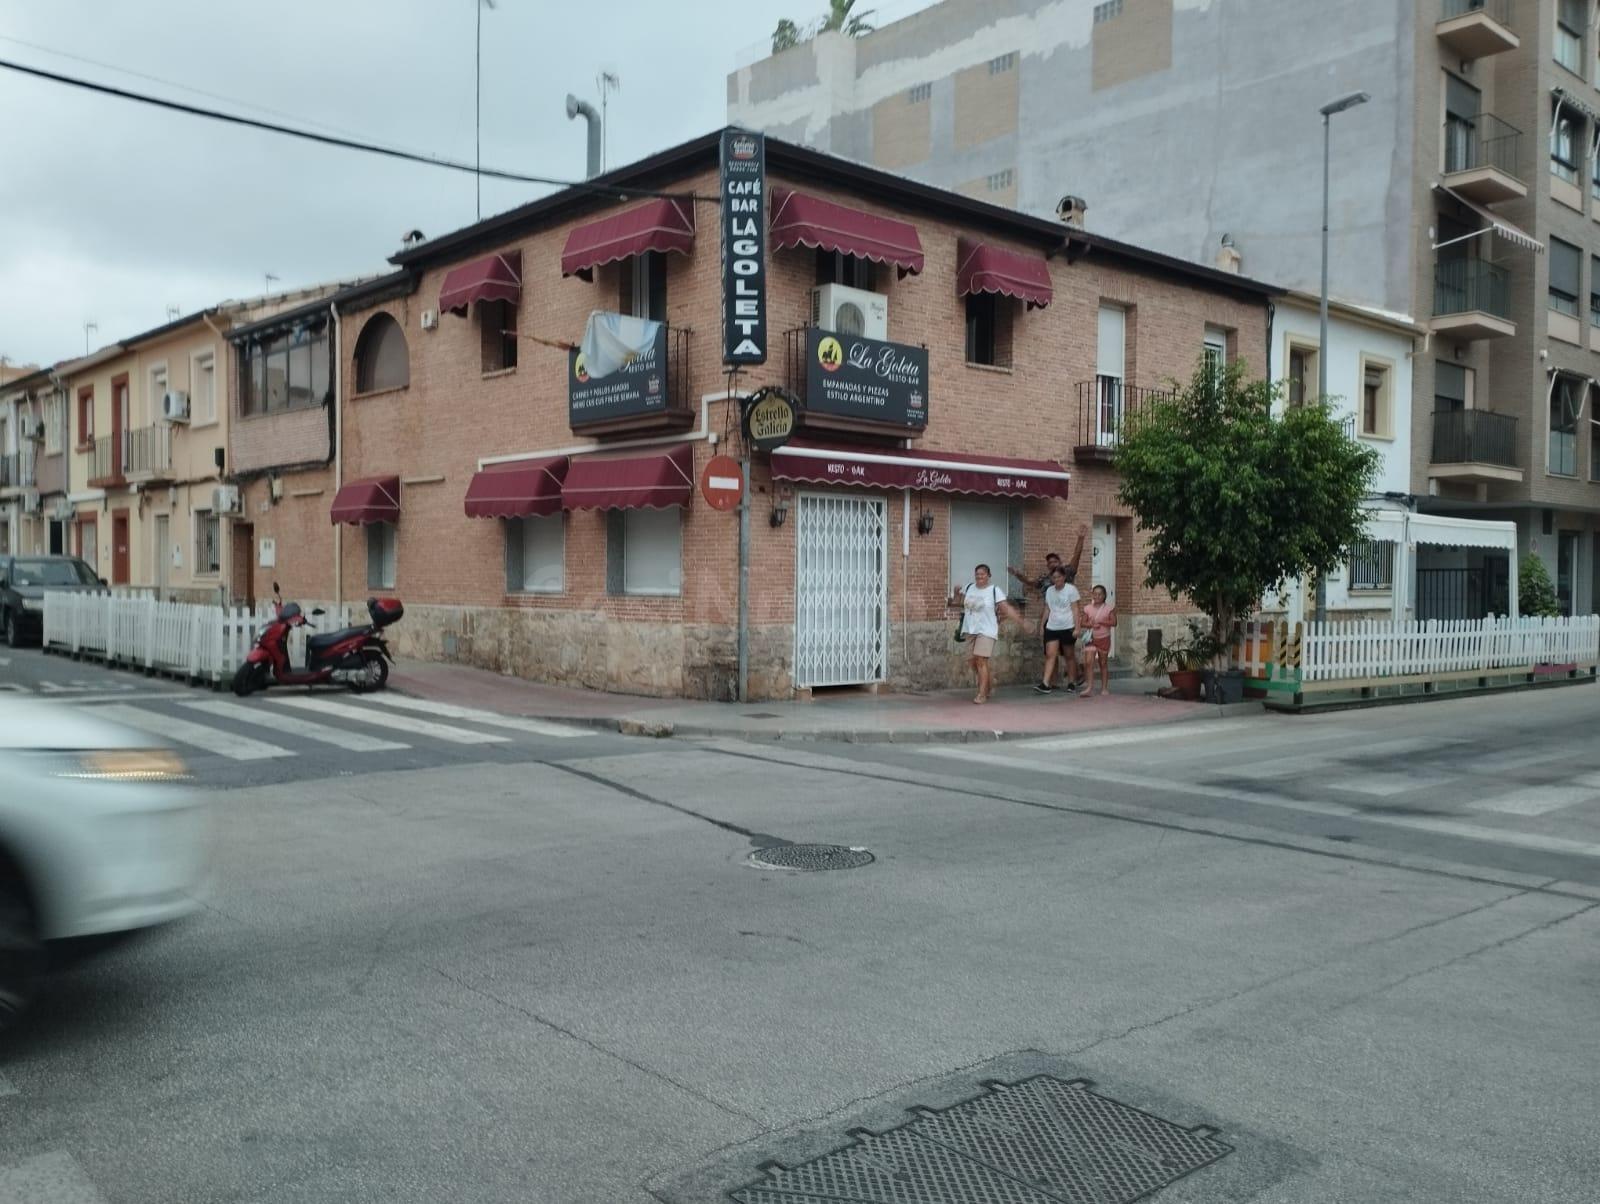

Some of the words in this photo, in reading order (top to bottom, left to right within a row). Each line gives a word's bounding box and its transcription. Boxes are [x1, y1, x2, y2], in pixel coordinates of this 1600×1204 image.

[728, 179, 760, 195] CAFÉ
[731, 198, 758, 212] BAR
[732, 217, 758, 236] LA
[733, 239, 761, 355] GOLETA
[629, 363, 645, 373] RESTO
[646, 361, 656, 370] BAR
[847, 342, 873, 369] La
[875, 346, 919, 377] Goleta
[573, 390, 589, 400] CARNES
[594, 385, 610, 396] POLLOS
[611, 383, 630, 393] ASADOS
[823, 379, 861, 393] EMPANADAS
[862, 385, 867, 393] Y
[868, 386, 889, 397] PIZZAS
[604, 395, 613, 404] FIN
[613, 394, 620, 403] DE
[620, 391, 639, 402] SEMANA
[827, 391, 848, 401] ESTILO
[849, 394, 885, 406] ARGENTINO
[756, 405, 789, 422] Estrella
[757, 421, 788, 436] Galicia
